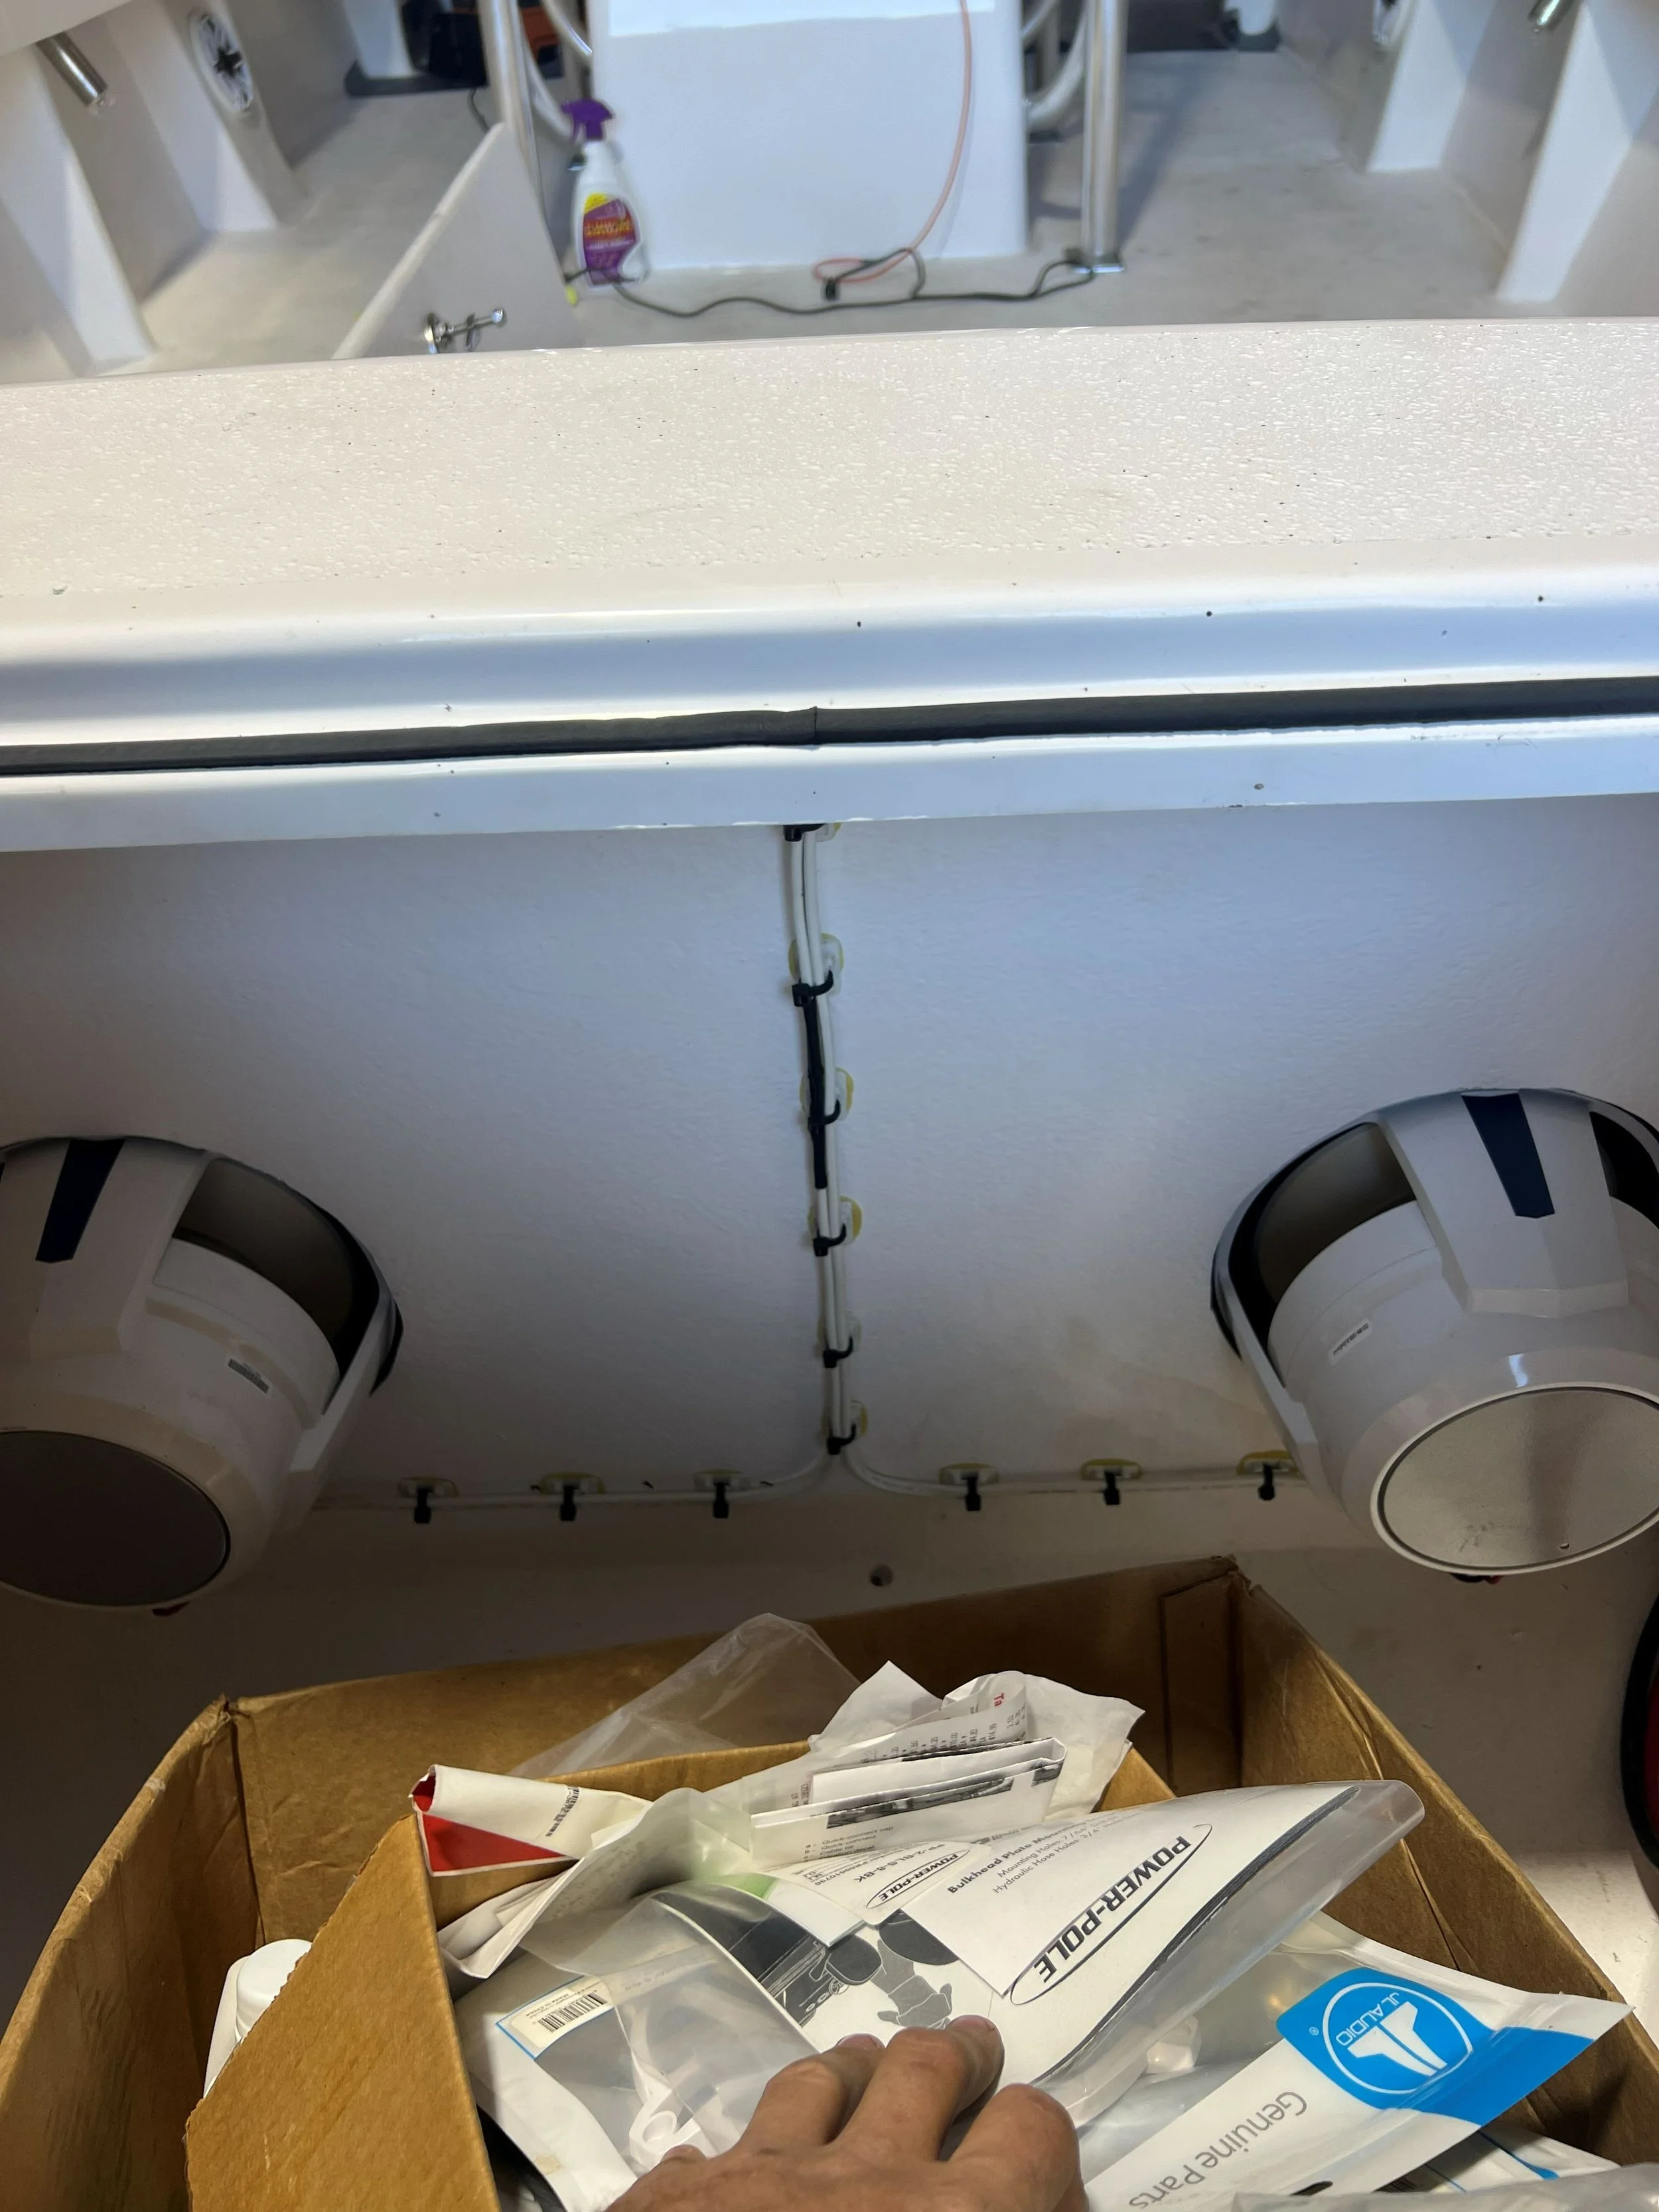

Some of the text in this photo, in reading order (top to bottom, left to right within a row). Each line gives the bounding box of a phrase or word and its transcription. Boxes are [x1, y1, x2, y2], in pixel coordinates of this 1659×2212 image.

[878, 1853, 959, 1902] POWER-POLE
[947, 1858, 1003, 1893] Bulkhead
[1002, 1843, 1033, 1860] Plate
[993, 1864, 1034, 1893] Hydraulic
[1033, 1851, 1056, 1867] Hose
[997, 1852, 1039, 1878] Mounting
[1033, 1835, 1192, 1984] POWER-POLE
[1335, 1992, 1400, 2046] JL AUDIO
[1128, 2091, 1307, 2209] Genuine Parts
